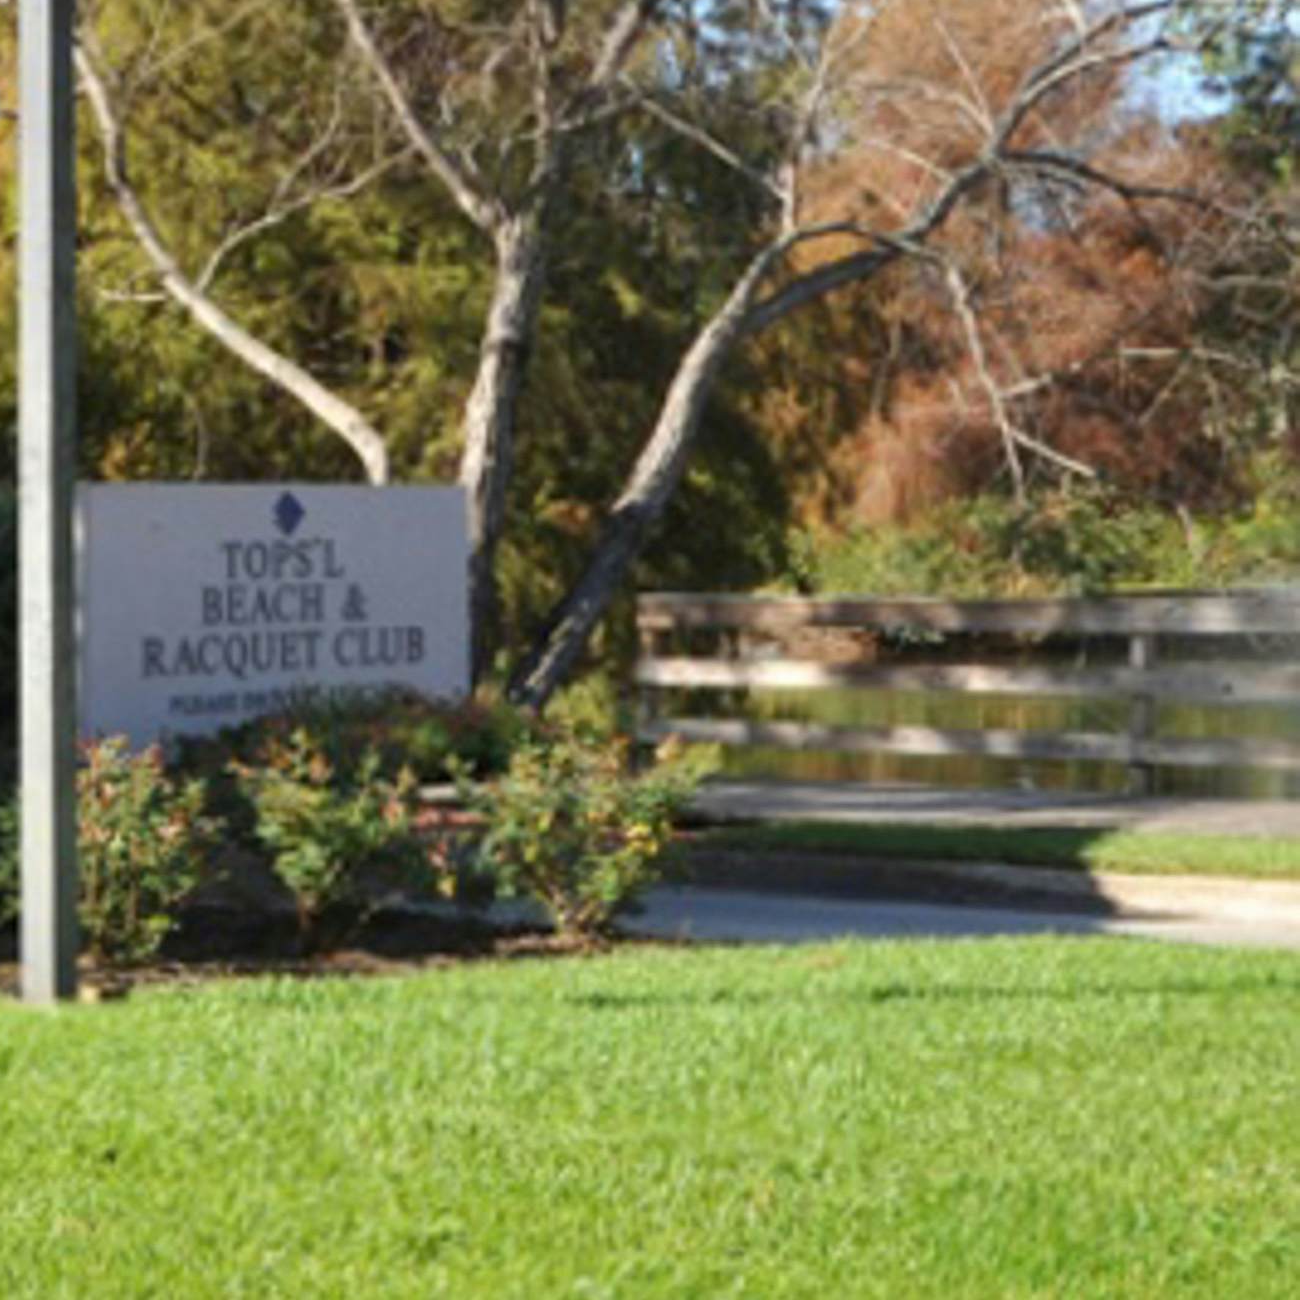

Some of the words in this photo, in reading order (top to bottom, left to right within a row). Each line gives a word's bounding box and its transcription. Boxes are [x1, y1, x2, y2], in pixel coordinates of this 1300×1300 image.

[220, 537, 345, 579] TOPS'L
[202, 582, 326, 625] BEACH
[340, 583, 368, 622] &
[140, 631, 323, 678] RACQUET
[333, 626, 425, 666] CLUB
